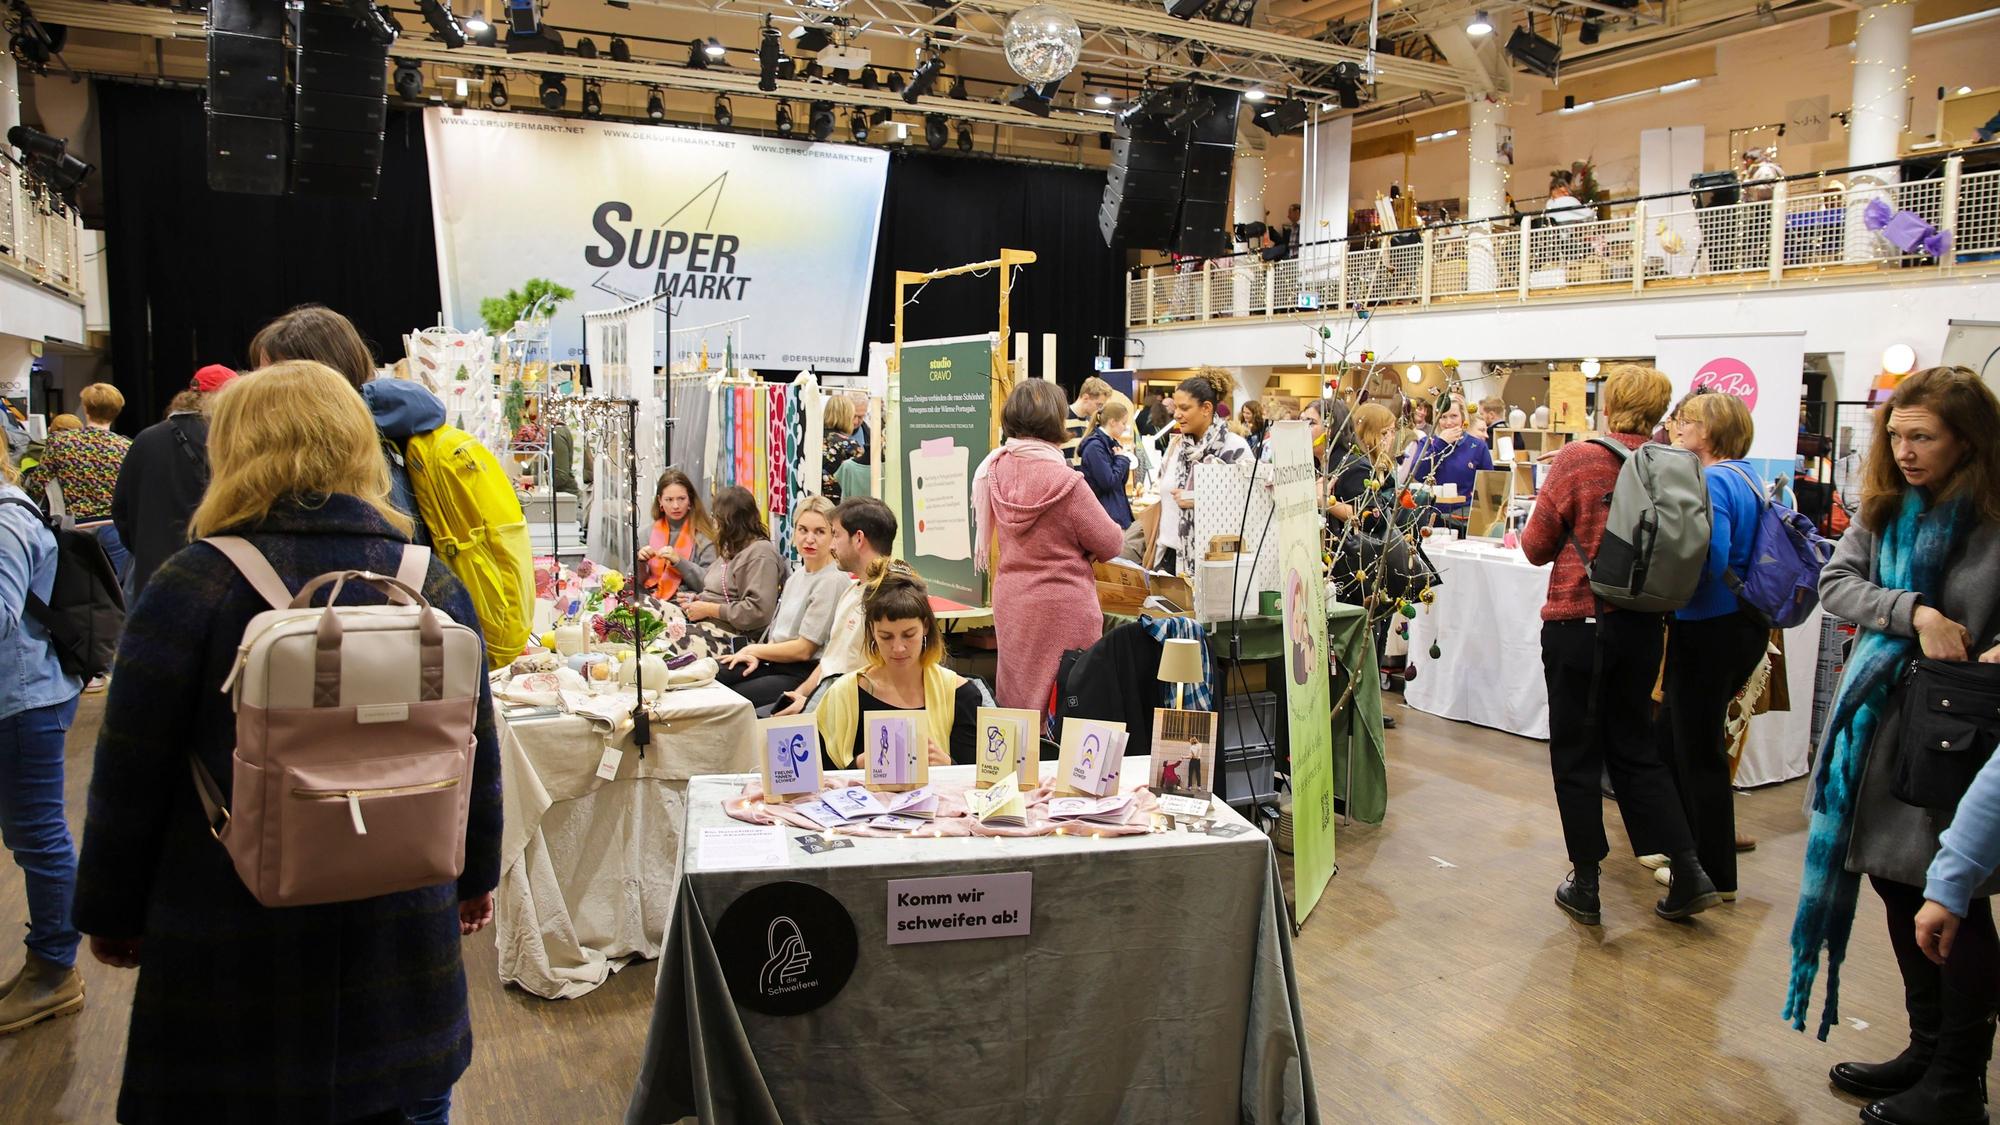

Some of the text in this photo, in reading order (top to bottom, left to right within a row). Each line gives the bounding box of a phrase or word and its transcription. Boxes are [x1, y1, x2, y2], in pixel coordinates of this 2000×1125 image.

[440, 116, 585, 135] WWW.DERSUPERMARKT.NET
[603, 129, 736, 149] WWW.DERSUPERMARKT.NET
[752, 144, 873, 164] WWW.DERSUPERMARKT.NET
[654, 272, 752, 301] MARKT
[782, 354, 855, 364] @DERSUPERMAR
[930, 356, 952, 369] studio
[929, 370, 952, 381] CRAVO
[897, 888, 985, 907] Komm wir
[897, 910, 1018, 931] schweifen ab!
[768, 979, 819, 996] Schweiferei
